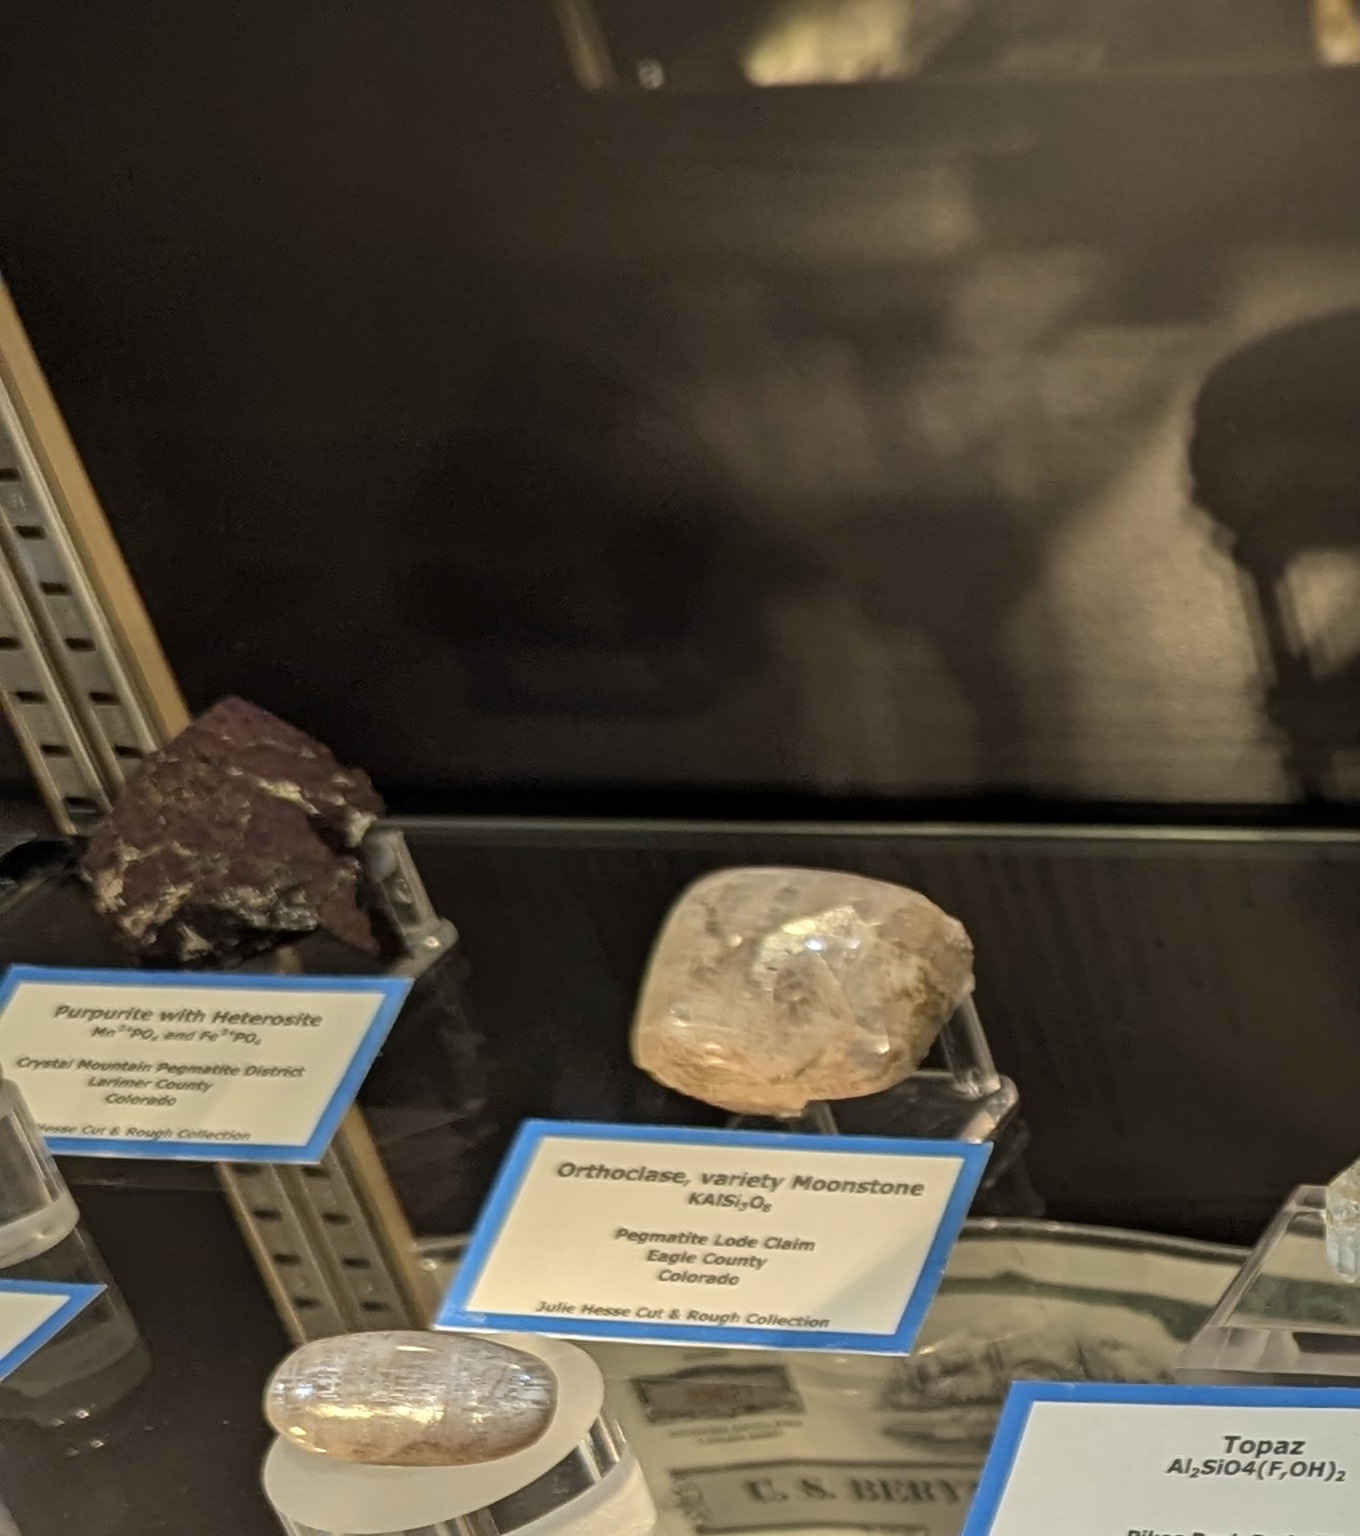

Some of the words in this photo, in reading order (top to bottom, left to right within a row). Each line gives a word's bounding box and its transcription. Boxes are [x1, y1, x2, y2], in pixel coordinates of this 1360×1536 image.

[54, 1005, 153, 1021] Purpurite
[159, 1009, 205, 1022] with
[212, 1011, 322, 1027] Heterosite
[164, 1030, 193, 1040] and
[16, 1057, 72, 1070] Crystal
[77, 1060, 152, 1072] Mountain
[157, 1063, 240, 1078] Pegmatite
[244, 1065, 305, 1077] District
[87, 1076, 152, 1089] Larimer
[156, 1079, 213, 1092] County
[105, 1093, 177, 1106] Colorado
[556, 1161, 692, 1188] Orthoclase,
[700, 1170, 784, 1192] variety
[791, 1173, 924, 1196] Moonstone
[615, 1228, 708, 1249] Pegmatite
[713, 1233, 759, 1249] Lode
[764, 1234, 816, 1252] Claim
[646, 1249, 698, 1269] Eagle
[702, 1251, 768, 1270] County
[658, 1269, 739, 1286] Colorado
[535, 1300, 576, 1314] Julie
[580, 1303, 630, 1319] Hesse
[635, 1305, 665, 1319] Cut
[669, 1307, 682, 1321] &
[686, 1309, 741, 1326] Rough
[745, 1312, 830, 1329] Collection
[1222, 1435, 1305, 1458] Topaz
[849, 1479, 972, 1503] BERY
